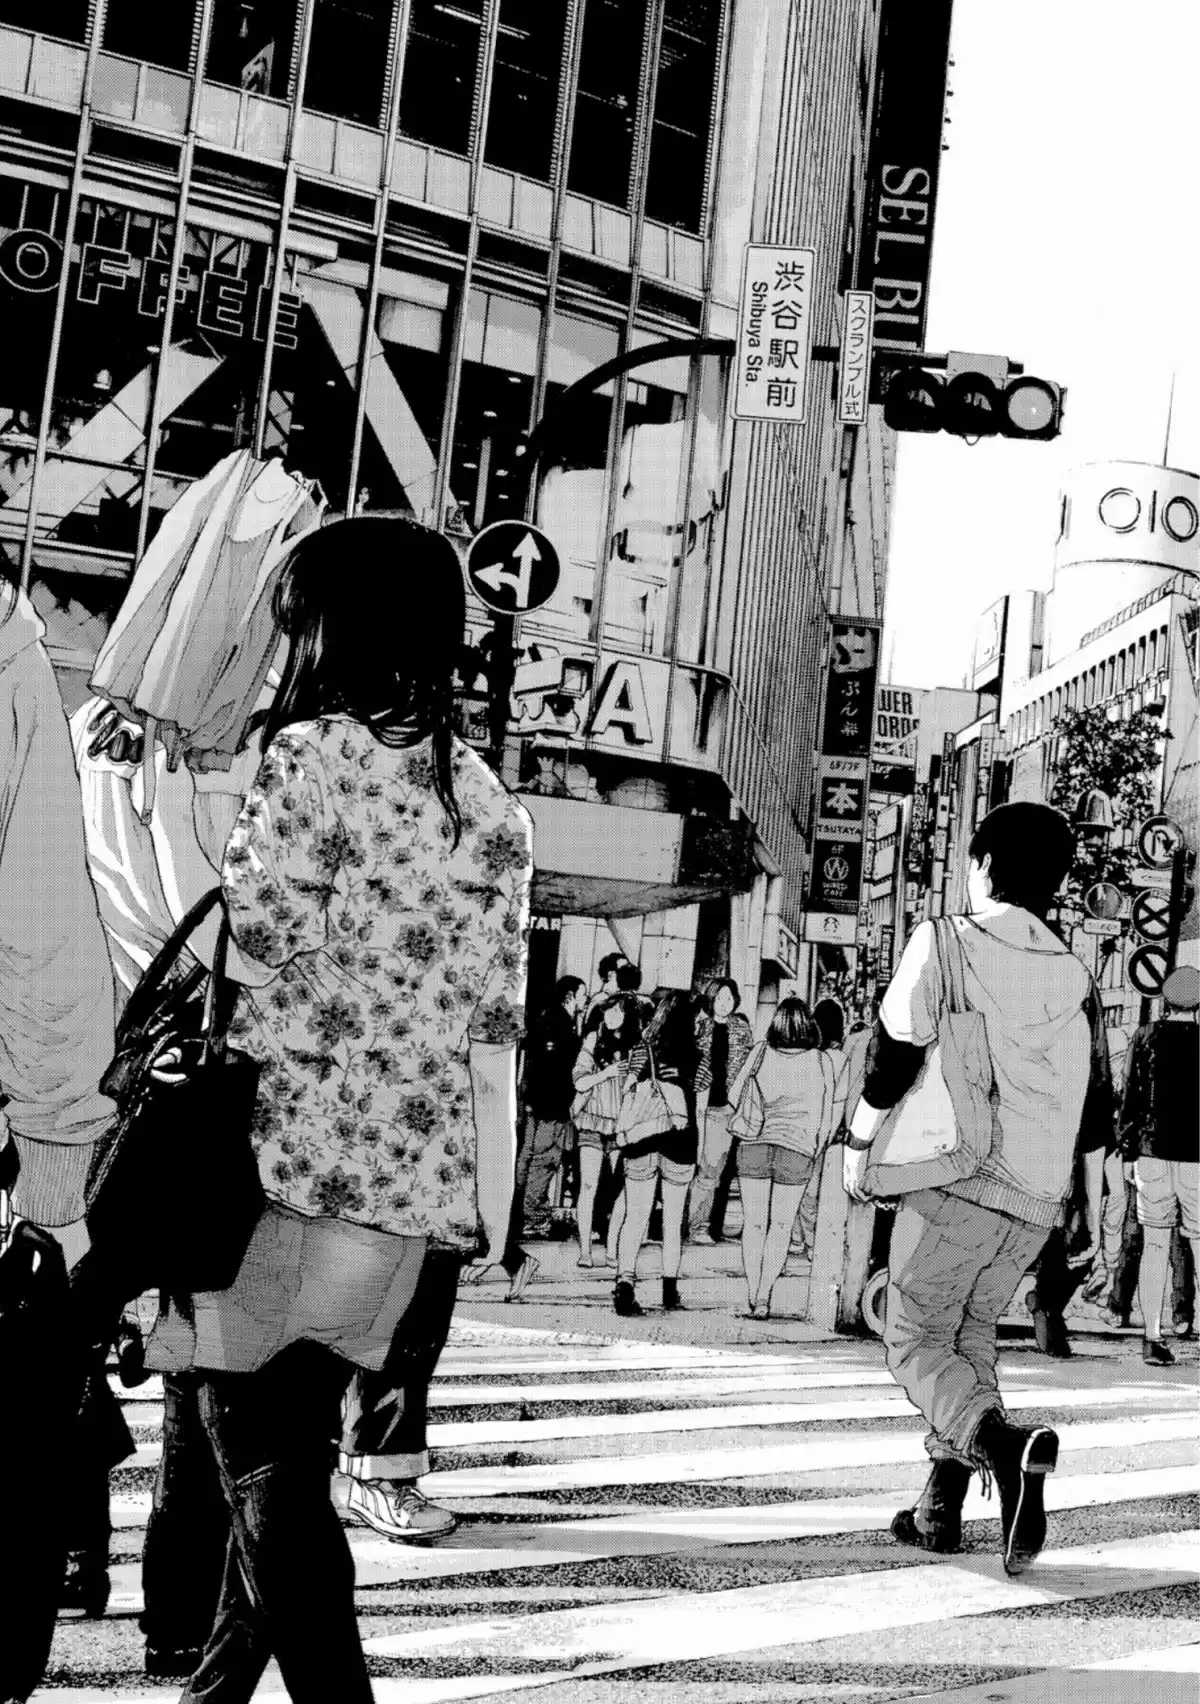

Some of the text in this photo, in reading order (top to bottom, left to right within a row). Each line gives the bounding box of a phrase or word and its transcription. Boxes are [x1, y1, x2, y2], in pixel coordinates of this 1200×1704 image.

[744, 280, 768, 388] Shibuya Sta.
[766, 260, 805, 408] 渋谷駅前
[826, 782, 859, 815] 本
